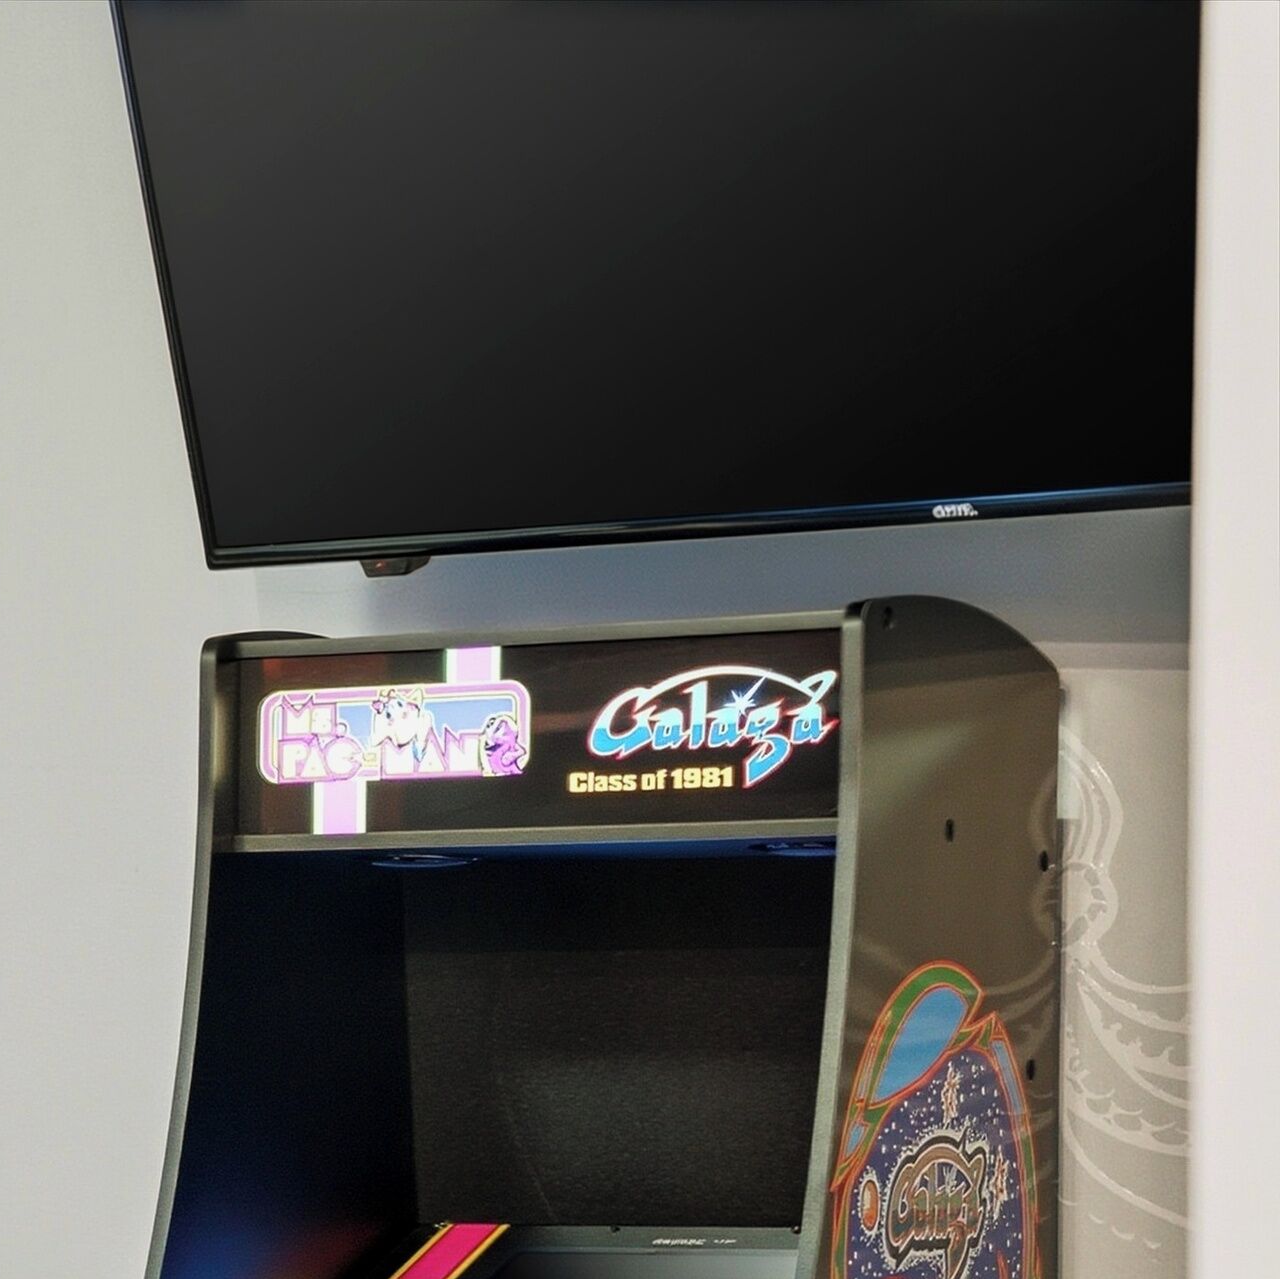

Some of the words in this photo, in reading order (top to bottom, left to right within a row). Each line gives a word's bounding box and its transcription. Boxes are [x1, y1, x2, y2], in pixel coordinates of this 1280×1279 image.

[589, 664, 839, 788] Galaga
[568, 771, 637, 793] Class
[641, 769, 667, 790] of
[670, 766, 734, 789] 1981
